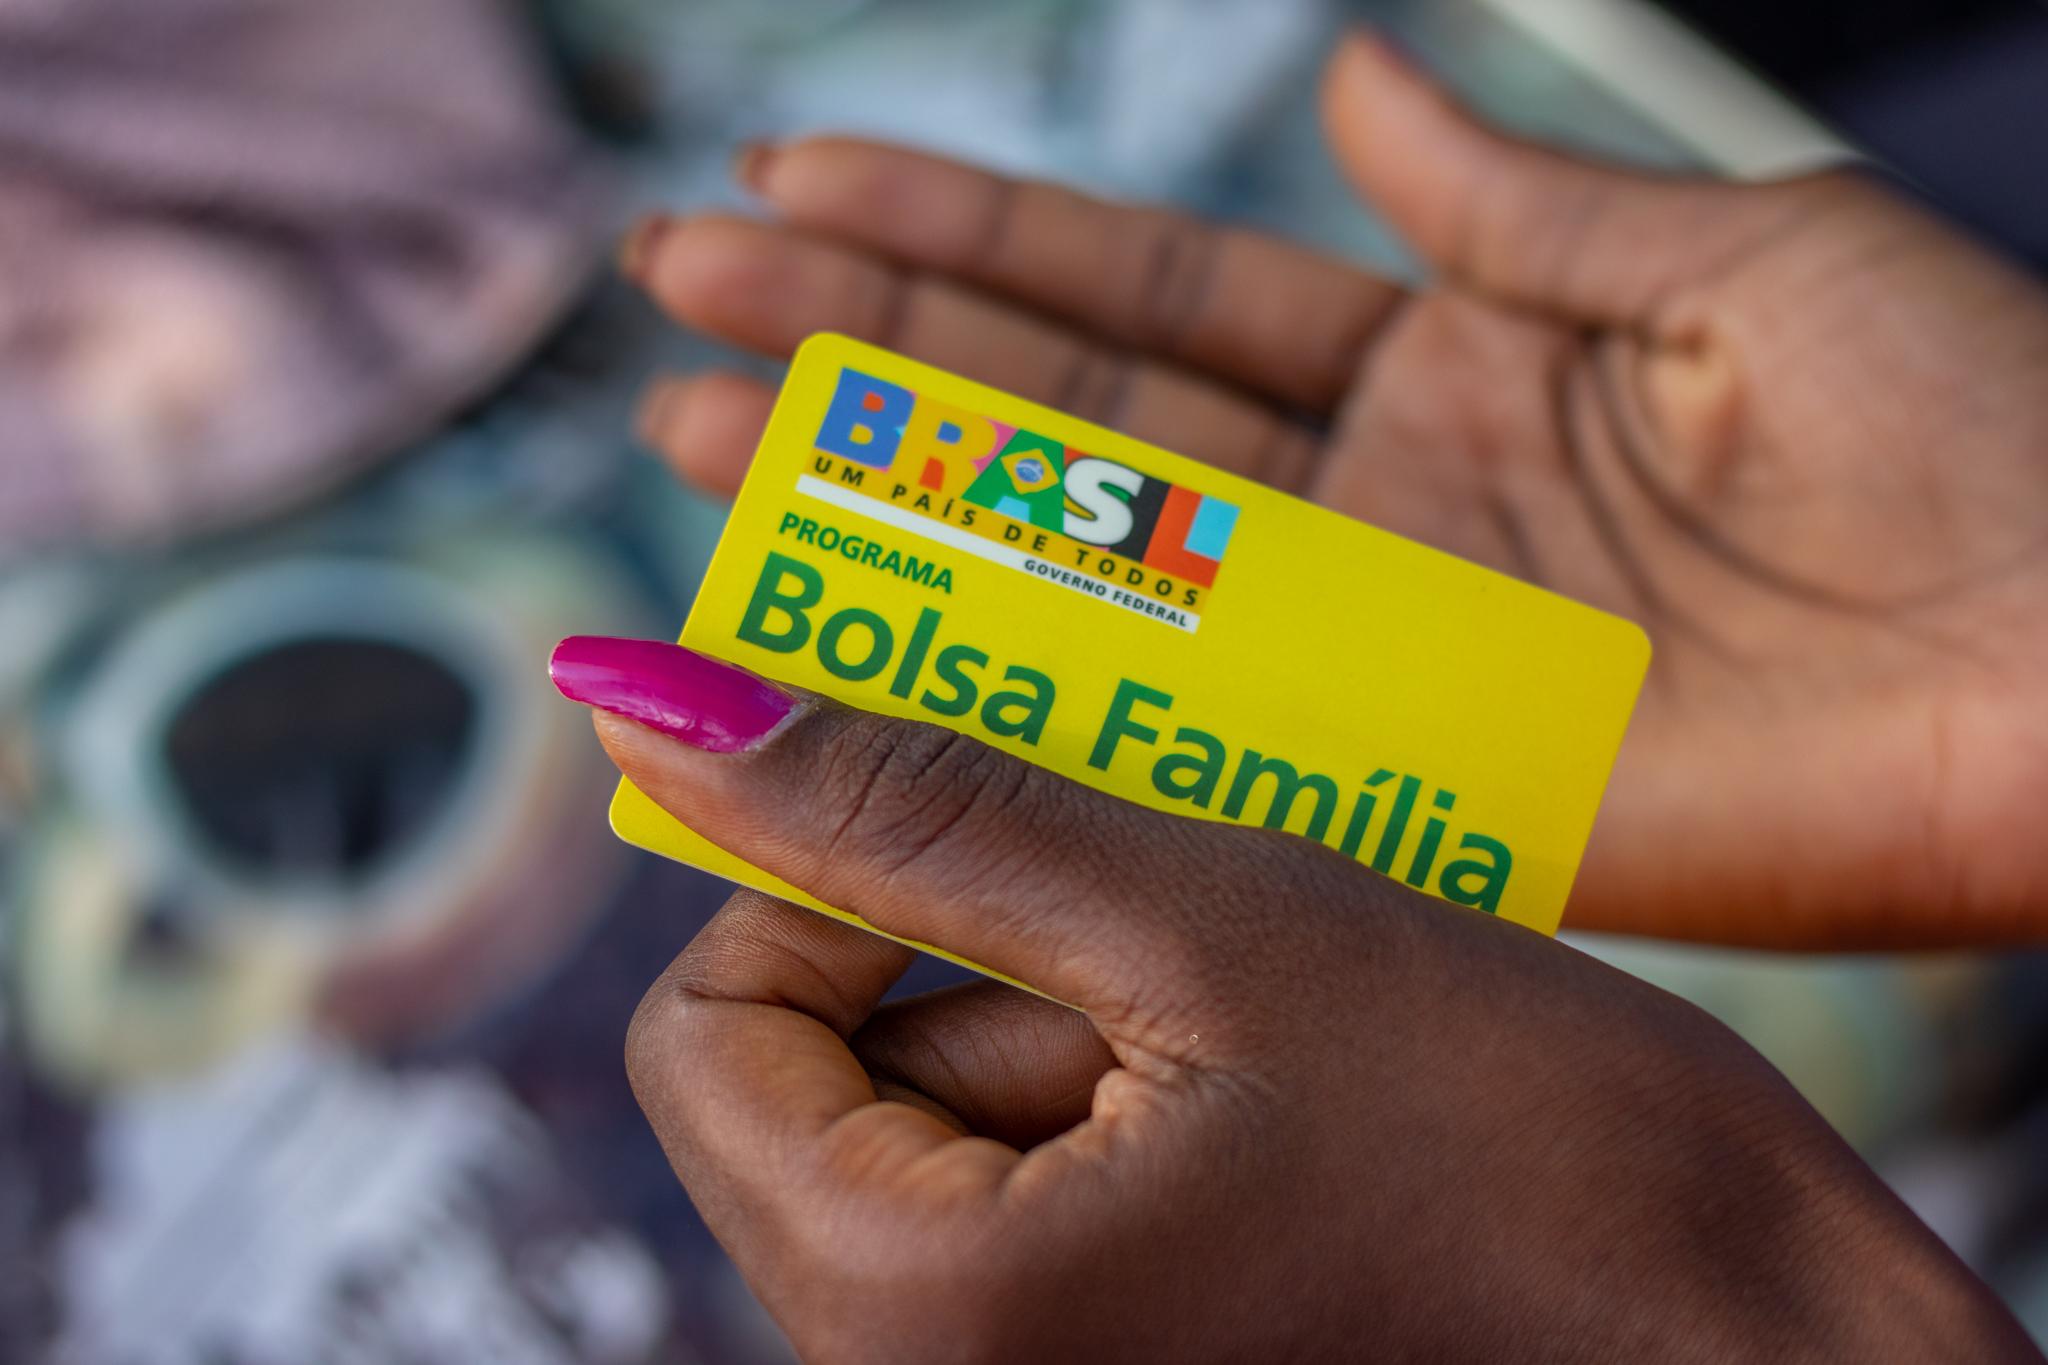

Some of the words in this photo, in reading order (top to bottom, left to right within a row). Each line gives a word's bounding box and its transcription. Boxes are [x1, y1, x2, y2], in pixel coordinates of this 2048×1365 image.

[779, 512, 953, 595] PROGRAMA
[813, 367, 1241, 589] BRASIL
[815, 456, 865, 487] UM
[891, 484, 976, 527] PAÍS
[1003, 525, 1048, 552] DE
[1076, 548, 1199, 607] TODOS
[1024, 559, 1107, 596] GOVERNO
[1112, 590, 1188, 627] FEDERAL
[735, 551, 1056, 746] Bolsa
[1086, 677, 1514, 915] Família
